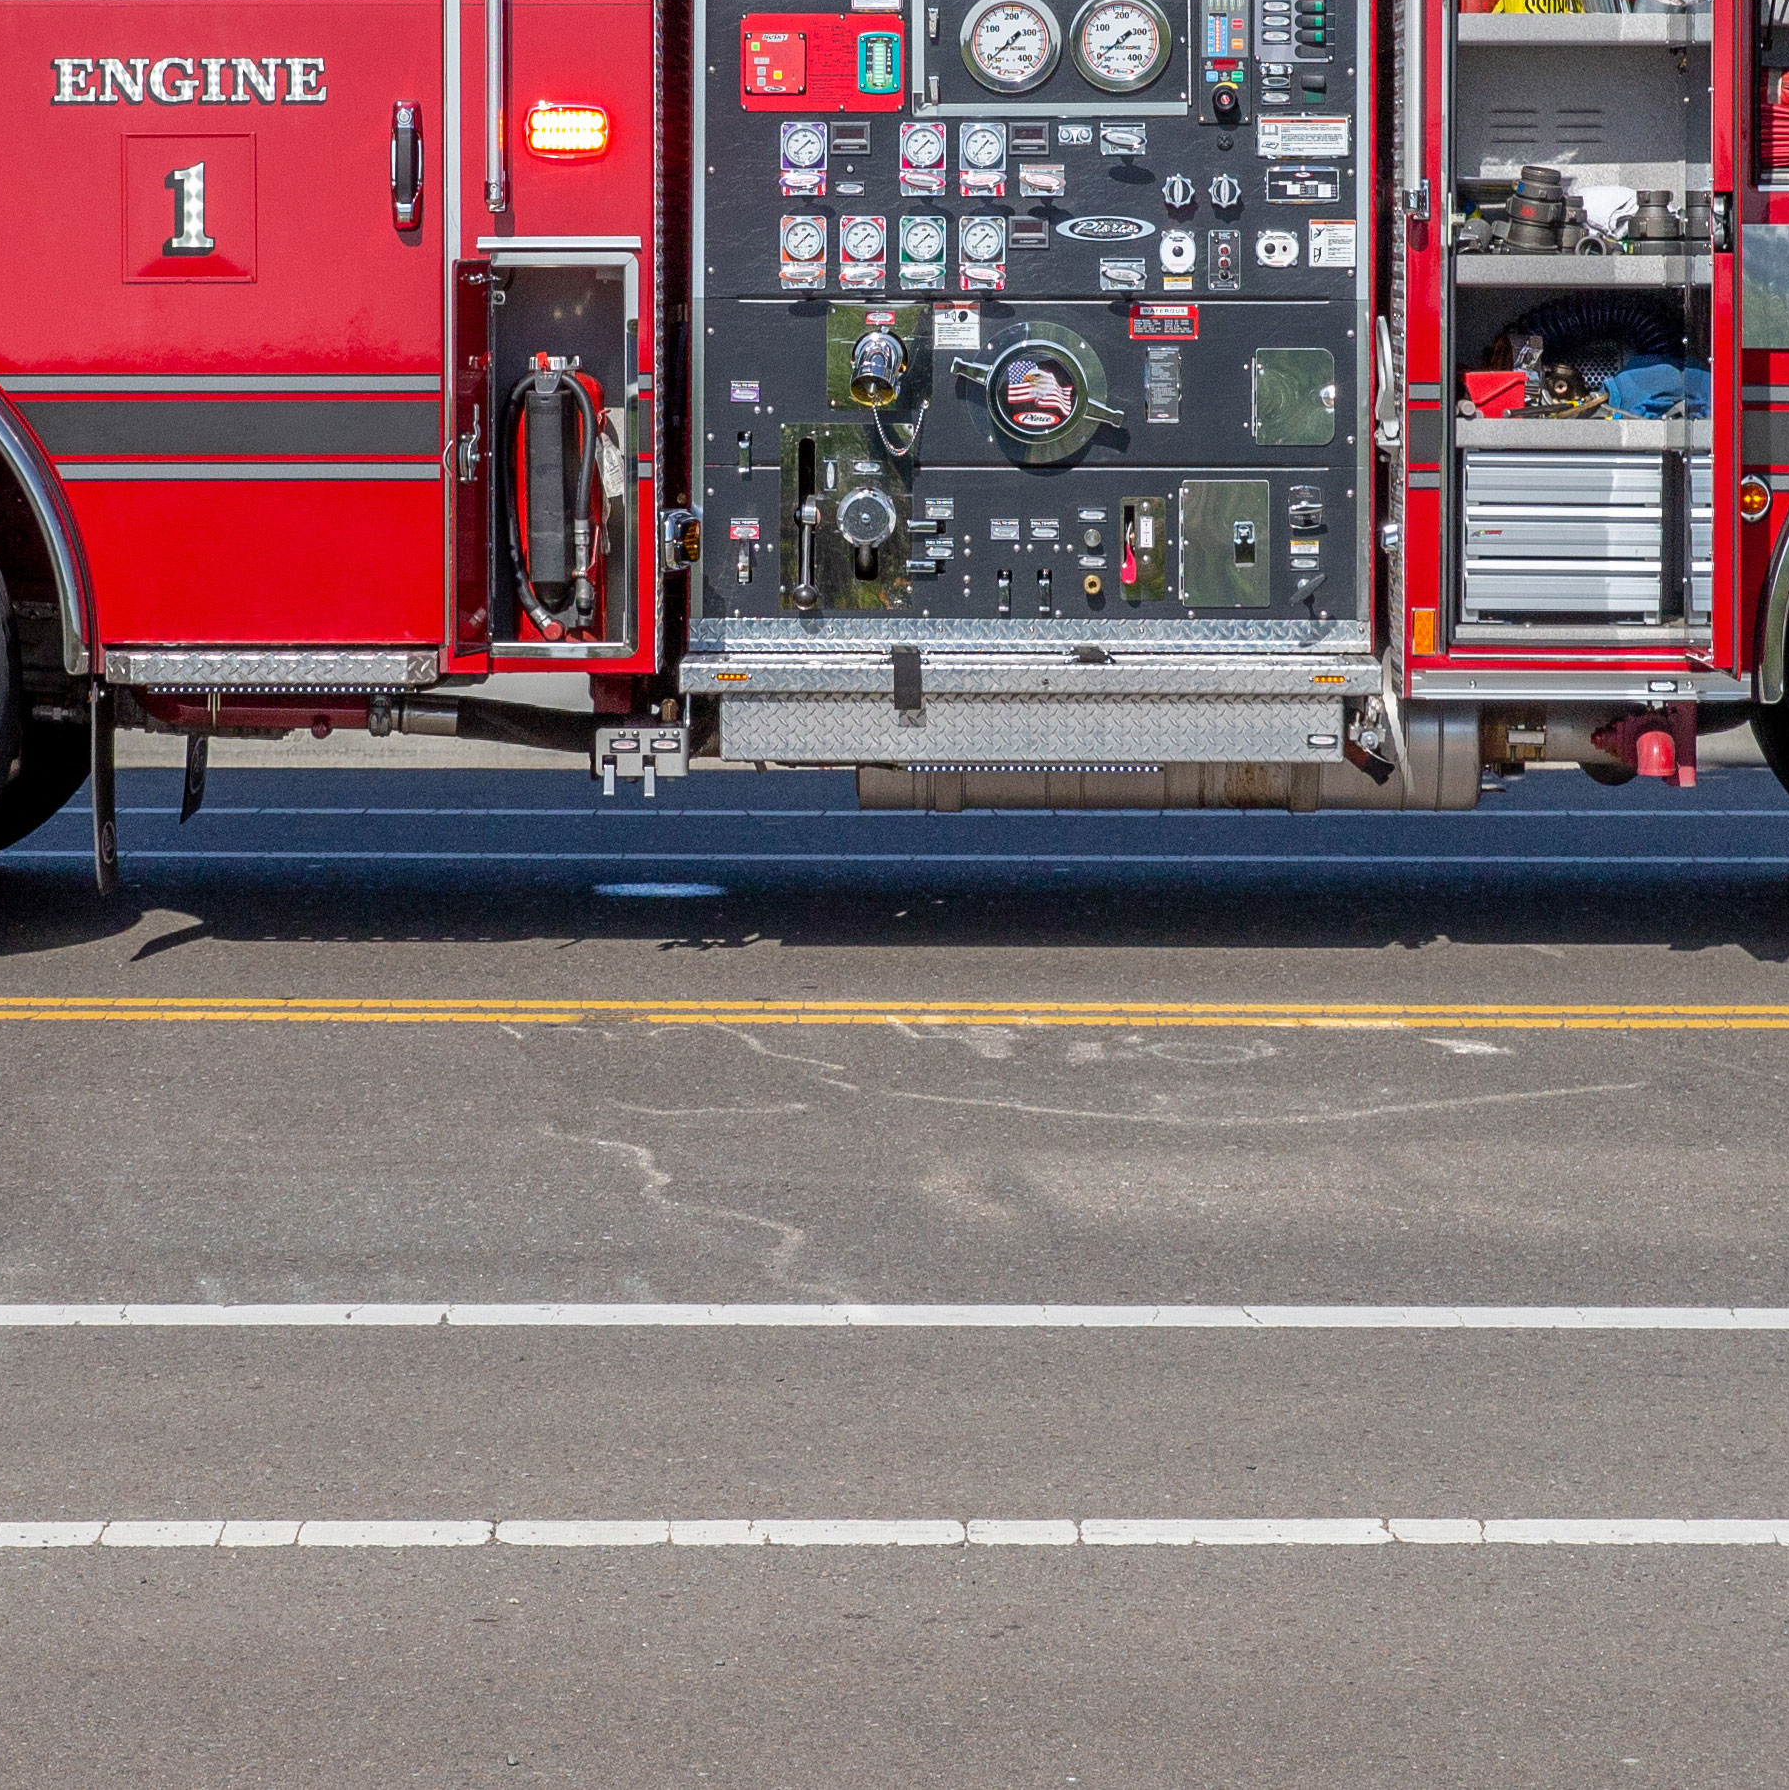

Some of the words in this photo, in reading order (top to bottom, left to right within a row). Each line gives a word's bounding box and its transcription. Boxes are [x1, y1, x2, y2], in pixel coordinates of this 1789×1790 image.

[1004, 12, 1019, 20] 200
[1114, 11, 1130, 20] 200
[985, 25, 1000, 33] 100
[1022, 28, 1037, 37] 300
[1095, 24, 1110, 32] 100
[1132, 27, 1147, 36] 300
[1017, 54, 1032, 62] 400
[1127, 53, 1142, 61] 400
[50, 57, 328, 106] ENGINE
[162, 161, 216, 257] 1
[1074, 220, 1139, 234] Pierce
[1021, 413, 1053, 424] Pierce
